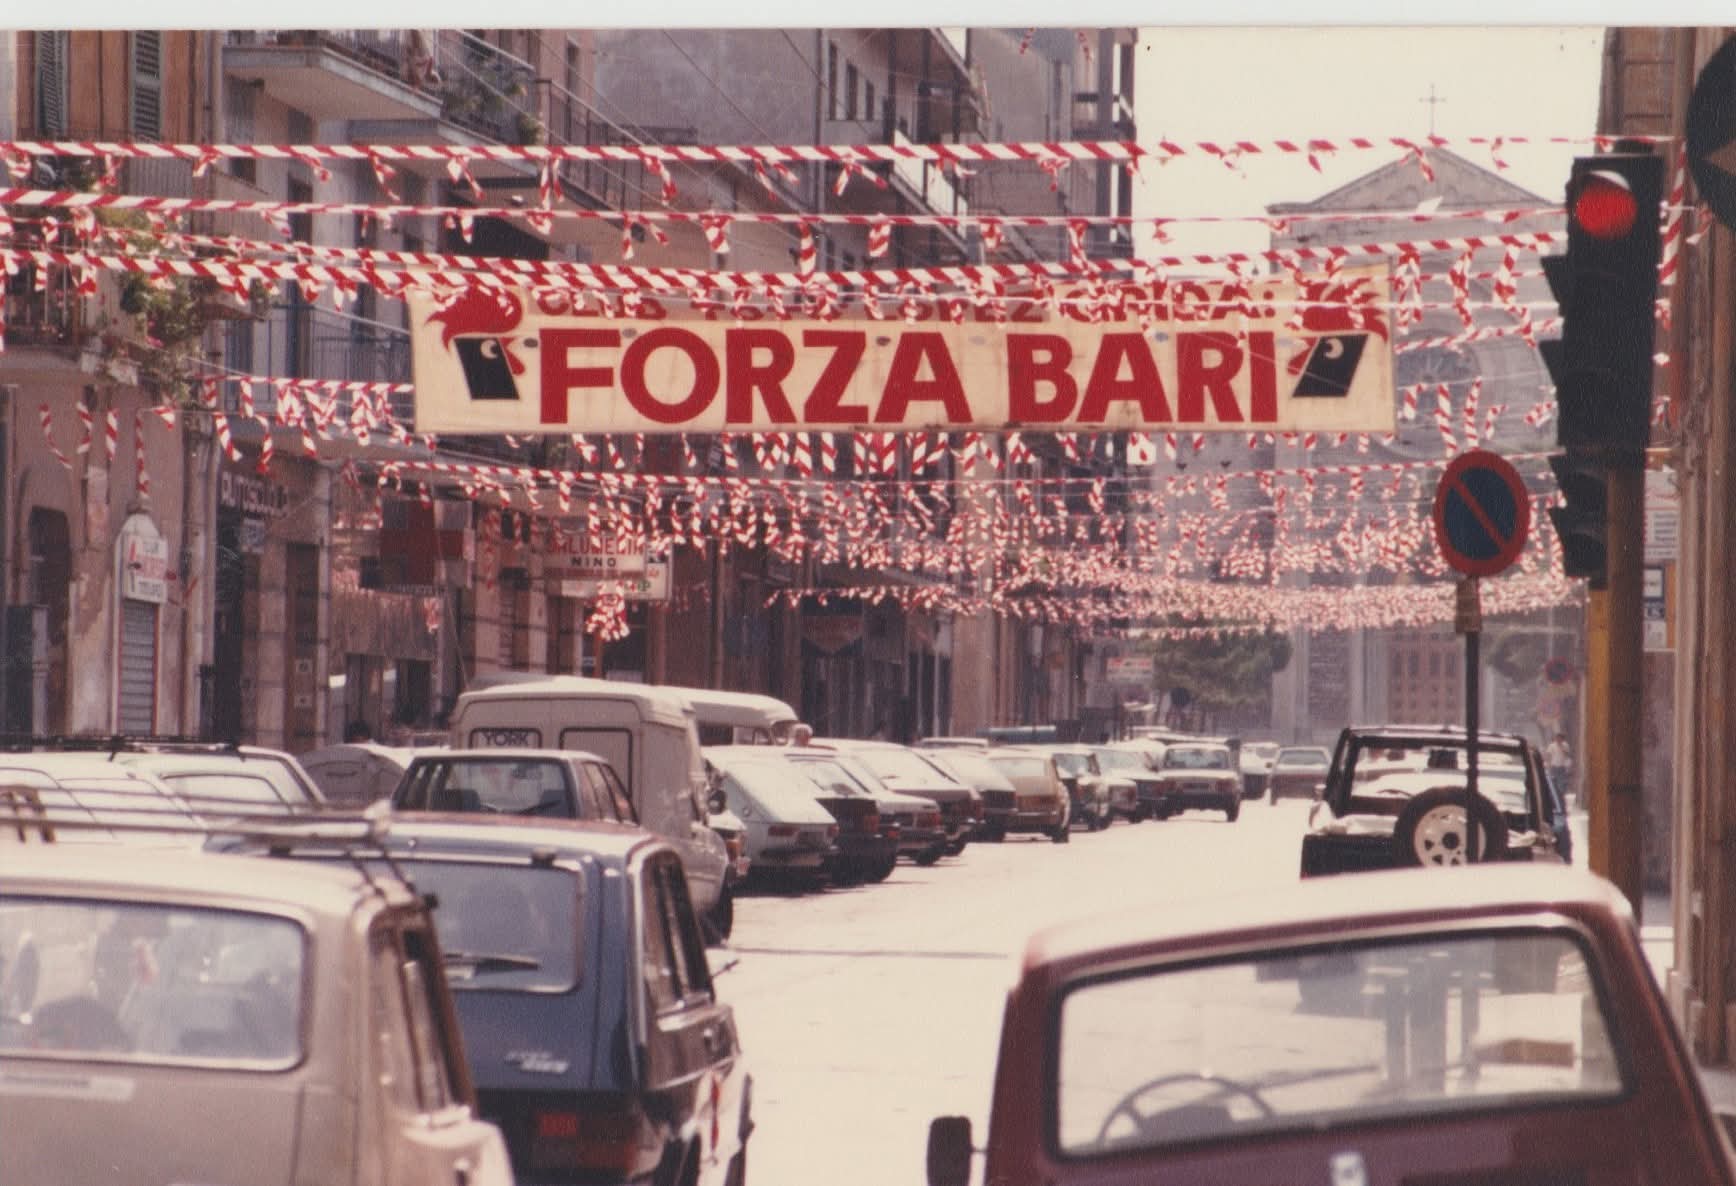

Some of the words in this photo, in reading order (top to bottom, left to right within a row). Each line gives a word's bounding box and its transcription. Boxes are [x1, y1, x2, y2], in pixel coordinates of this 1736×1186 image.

[540, 329, 972, 425] FORZA
[1006, 329, 1277, 425] BARI
[571, 557, 617, 568] NINO
[482, 730, 529, 747] YORK
